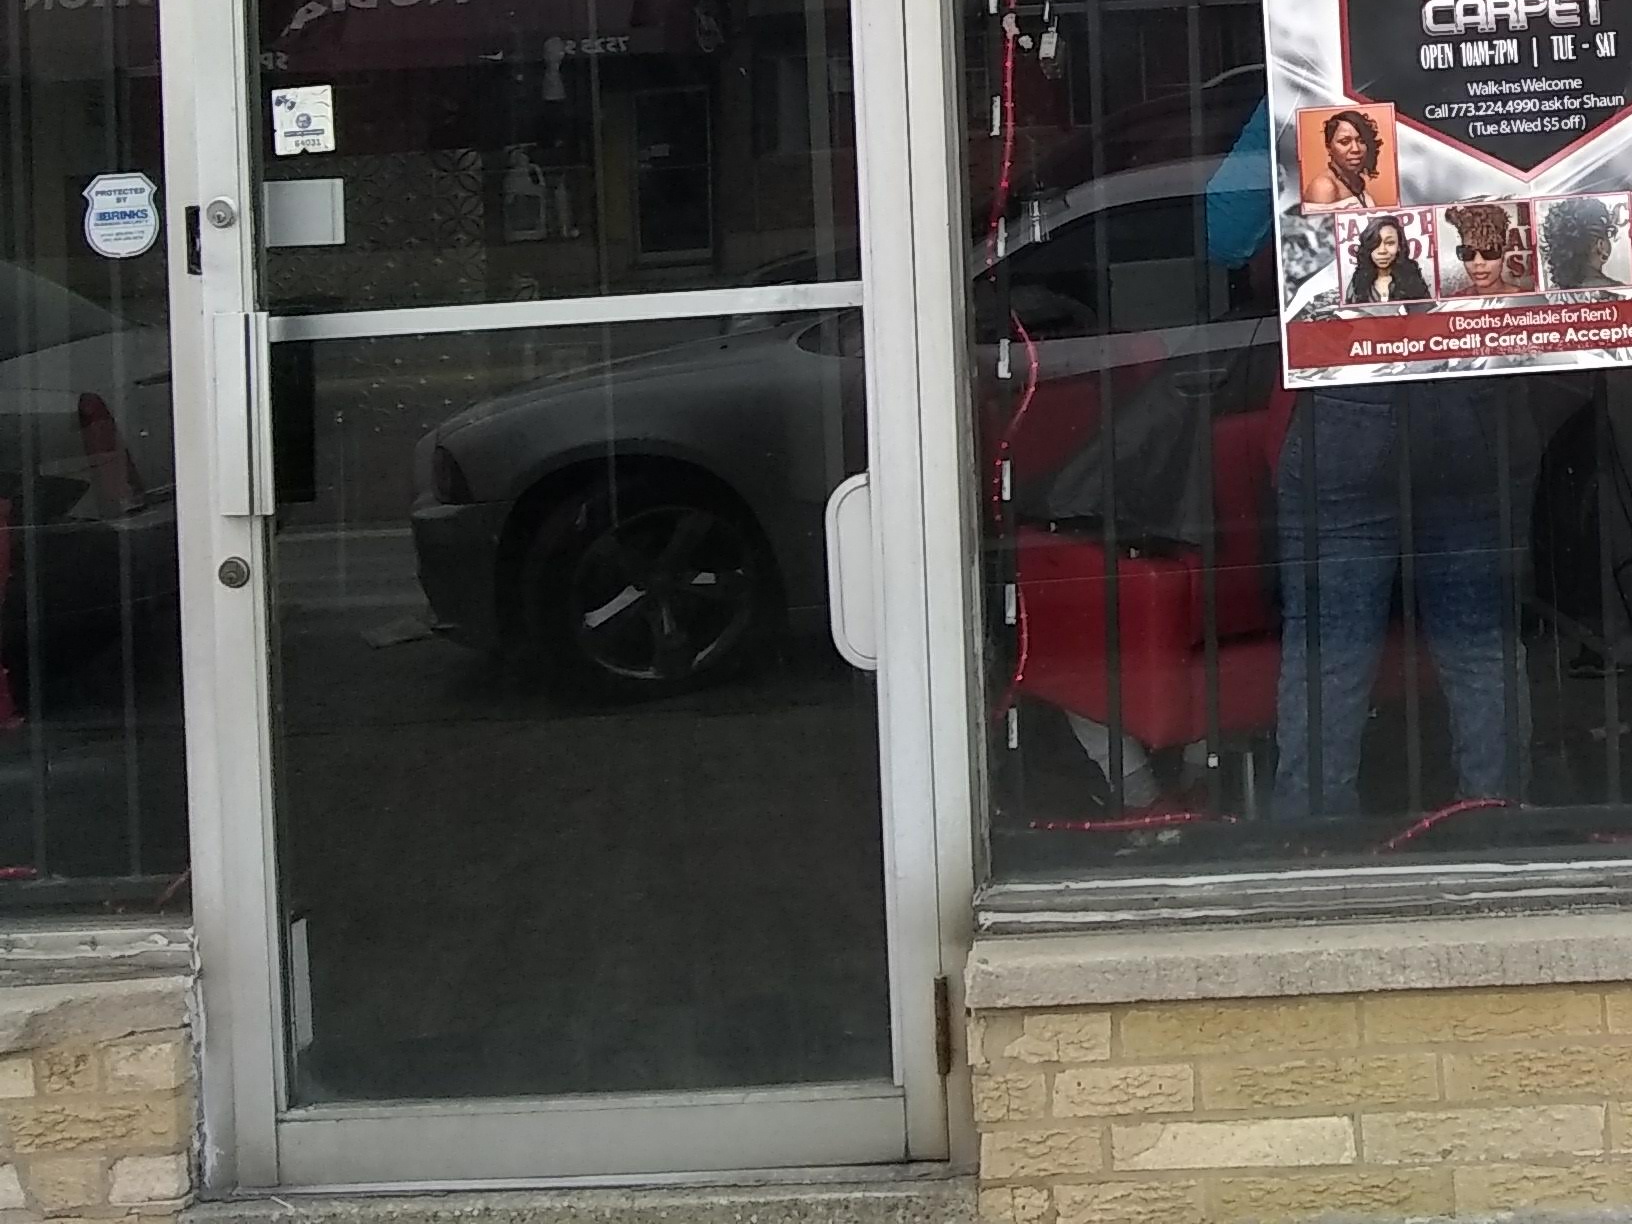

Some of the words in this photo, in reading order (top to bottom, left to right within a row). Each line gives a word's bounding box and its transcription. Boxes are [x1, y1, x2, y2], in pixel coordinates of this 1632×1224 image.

[1420, 42, 1454, 69] OPEN
[1460, 38, 1519, 68] 10AM-7PM
[1551, 34, 1577, 61] TUE
[1595, 31, 1617, 58] SAT
[1466, 80, 1521, 96] Walk-Ins
[1521, 77, 1582, 94] Welcome
[1425, 102, 1449, 119] Call
[1450, 99, 1540, 117] 773.224.4990
[1541, 96, 1563, 111] ask
[1563, 95, 1583, 109] for
[1583, 93, 1625, 108] Shaun
[1543, 116, 1559, 132] $5
[95, 187, 146, 197] PROTECTED
[1502, 310, 1560, 327] Available
[1561, 309, 1580, 323] for
[1350, 340, 1372, 357] All
[1376, 338, 1426, 357] major
[1429, 334, 1481, 351] Credit
[1484, 330, 1528, 347] Card
[1531, 331, 1560, 345] are
